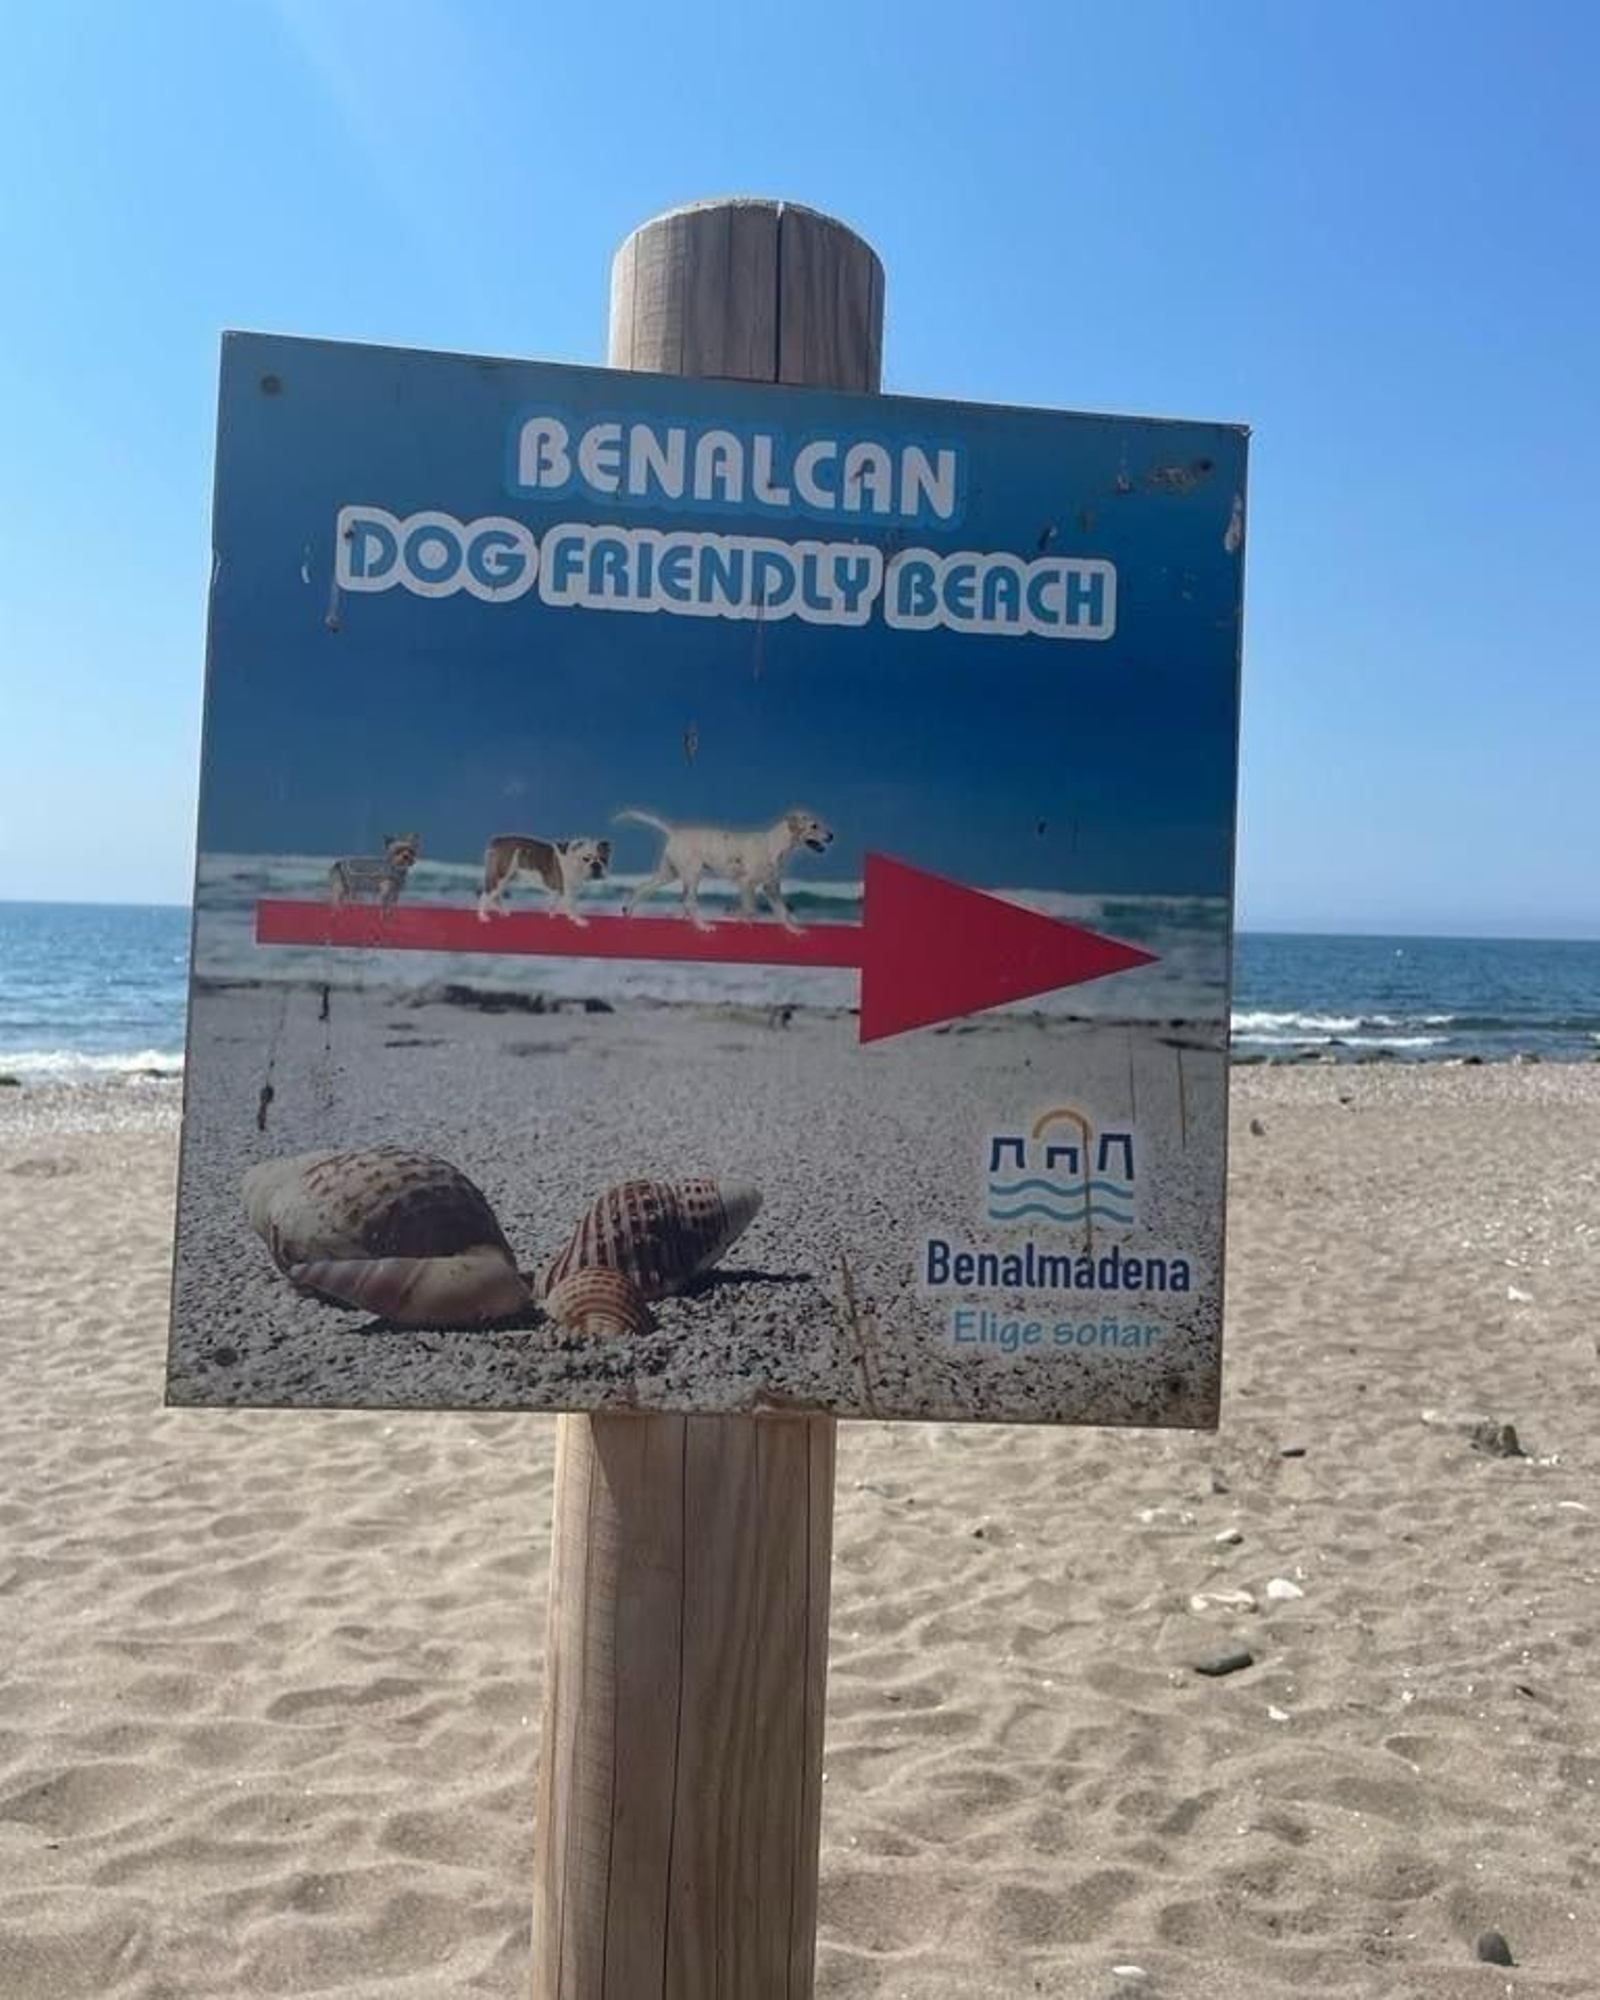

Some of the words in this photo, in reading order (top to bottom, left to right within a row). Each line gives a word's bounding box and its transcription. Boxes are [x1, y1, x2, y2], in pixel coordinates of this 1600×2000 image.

[518, 417, 956, 519] BENALCAN
[348, 521, 527, 588] DOG
[553, 536, 871, 614] FRIENDLY
[897, 559, 1106, 628] BEACH
[954, 1311, 1042, 1352] Elige
[1053, 1316, 1163, 1348] soñar
